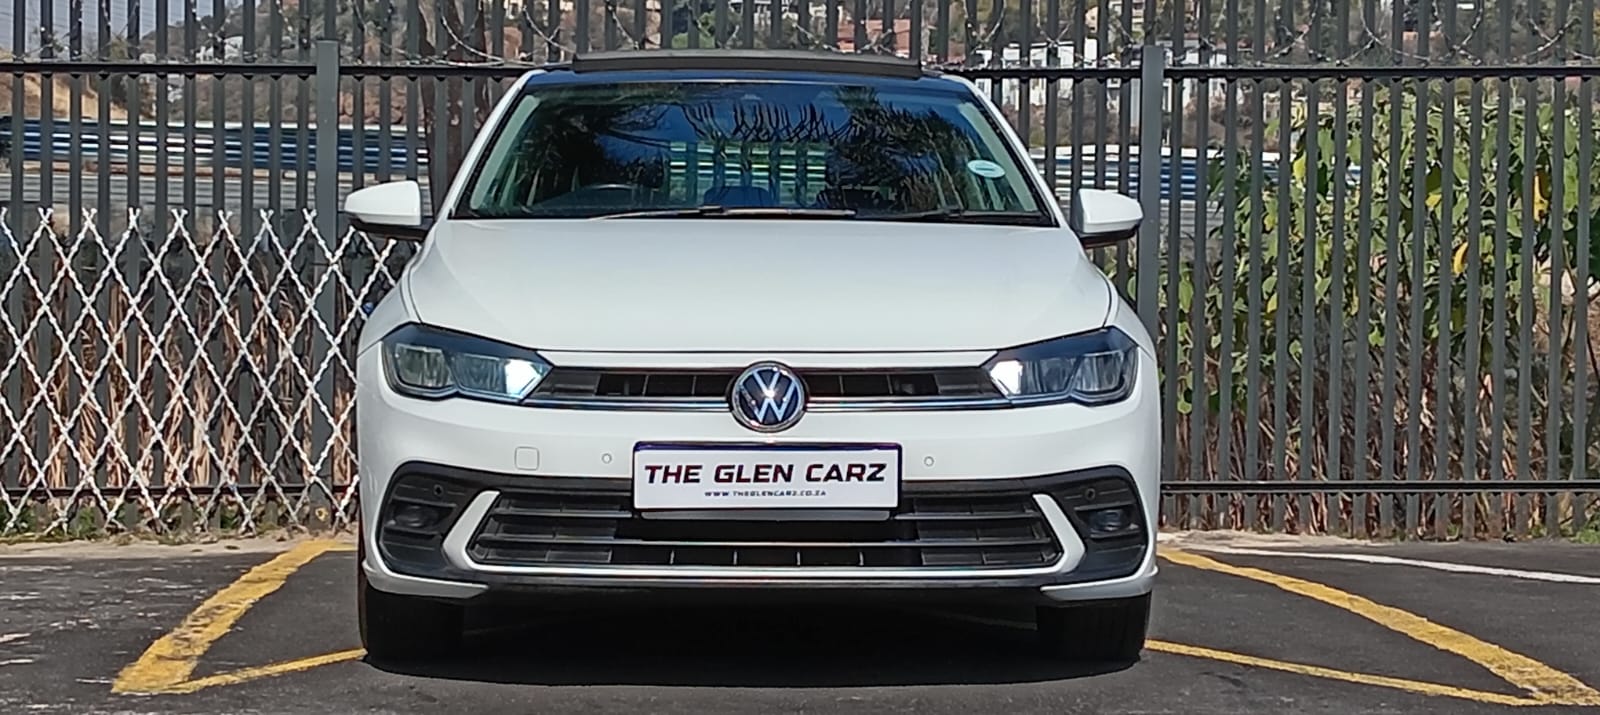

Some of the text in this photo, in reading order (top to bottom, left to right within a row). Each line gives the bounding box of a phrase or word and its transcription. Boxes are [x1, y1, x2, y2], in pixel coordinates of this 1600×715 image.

[738, 366, 798, 423] VW
[645, 463, 887, 484] THE GLEN CARZ
